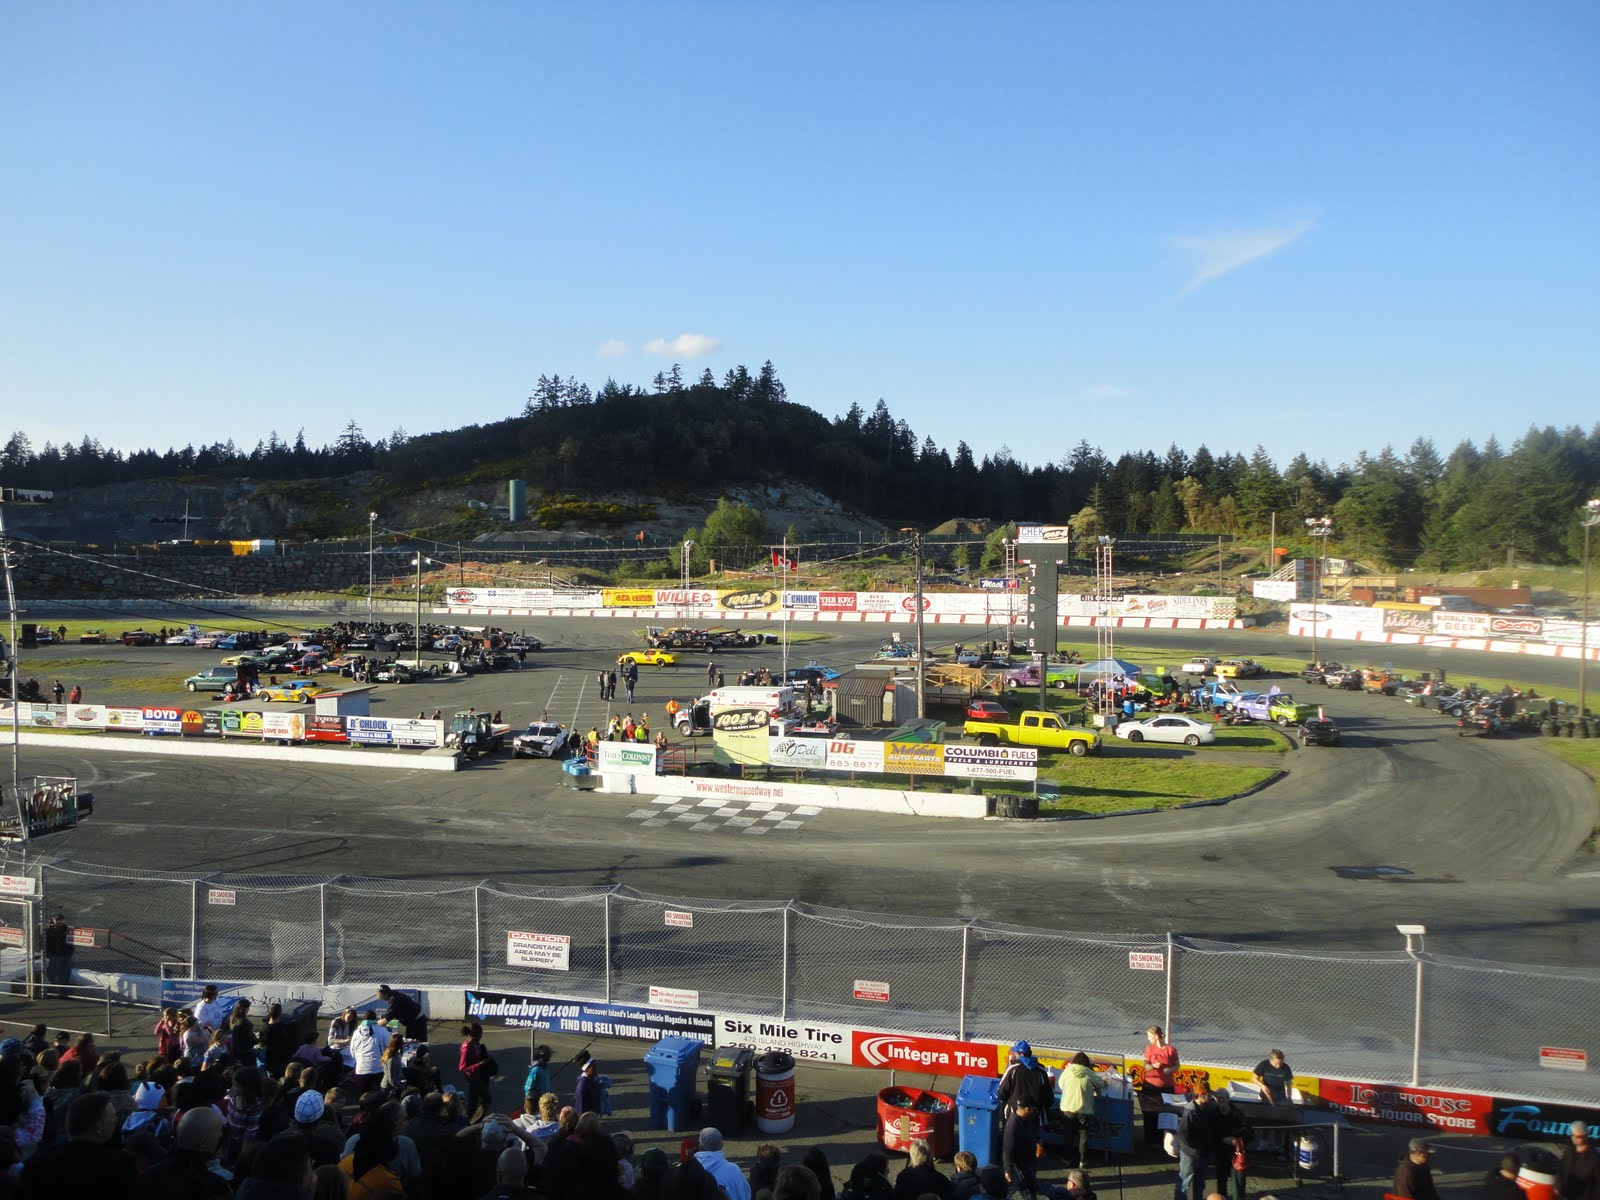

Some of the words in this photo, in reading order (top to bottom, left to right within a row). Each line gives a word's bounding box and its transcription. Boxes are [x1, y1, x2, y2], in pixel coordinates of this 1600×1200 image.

[1021, 527, 1044, 536] CHEK
[1031, 569, 1036, 577] 1
[1029, 586, 1036, 595] 2
[656, 591, 700, 603] WILLE
[1029, 604, 1035, 612] 3
[1029, 621, 1035, 630] 4
[1385, 614, 1432, 629] Market
[1444, 622, 1477, 631] BEEF
[1029, 638, 1035, 647] 5
[145, 709, 178, 720] BOYD
[829, 741, 857, 755] DG
[603, 750, 621, 760] TIMES
[622, 751, 653, 762] COLONIST
[1011, 750, 1036, 760] FUELS
[984, 759, 1034, 767] LUBRICANTS
[966, 767, 1017, 776] 1-877-500-FUEL
[216, 891, 235, 899] SMOKING
[666, 911, 672, 919] NO
[672, 912, 691, 921] SMOKING
[510, 932, 568, 943] CAUTION
[512, 942, 564, 951] GRANDSTAND
[521, 956, 554, 964] SLIPPERY
[1131, 953, 1139, 962] NO
[1139, 954, 1162, 963] SMOKING
[468, 997, 580, 1020] islandcarbuyer.com
[583, 1006, 608, 1016] Vancouver
[608, 1008, 626, 1018] Island's
[627, 1010, 646, 1022] Leading
[646, 1012, 664, 1023] Vehicle
[665, 1014, 688, 1025] Magazine
[688, 1017, 692, 1025] &
[693, 1017, 713, 1028] Website
[505, 1018, 550, 1029] 250-619-8470
[560, 1018, 580, 1031] FIND
[581, 1020, 593, 1032] OR
[594, 1022, 614, 1035] SELL
[614, 1024, 638, 1038] YOUR
[639, 1026, 661, 1040] NEXT
[724, 1019, 753, 1034] Six
[759, 1022, 799, 1039] Mile
[805, 1027, 843, 1044] Tire
[758, 1037, 787, 1047] ISLAND
[787, 1040, 824, 1050] HIGHWAY
[888, 1043, 949, 1066] Integra
[954, 1051, 988, 1069] Tire
[1426, 1112, 1476, 1129] STORE
